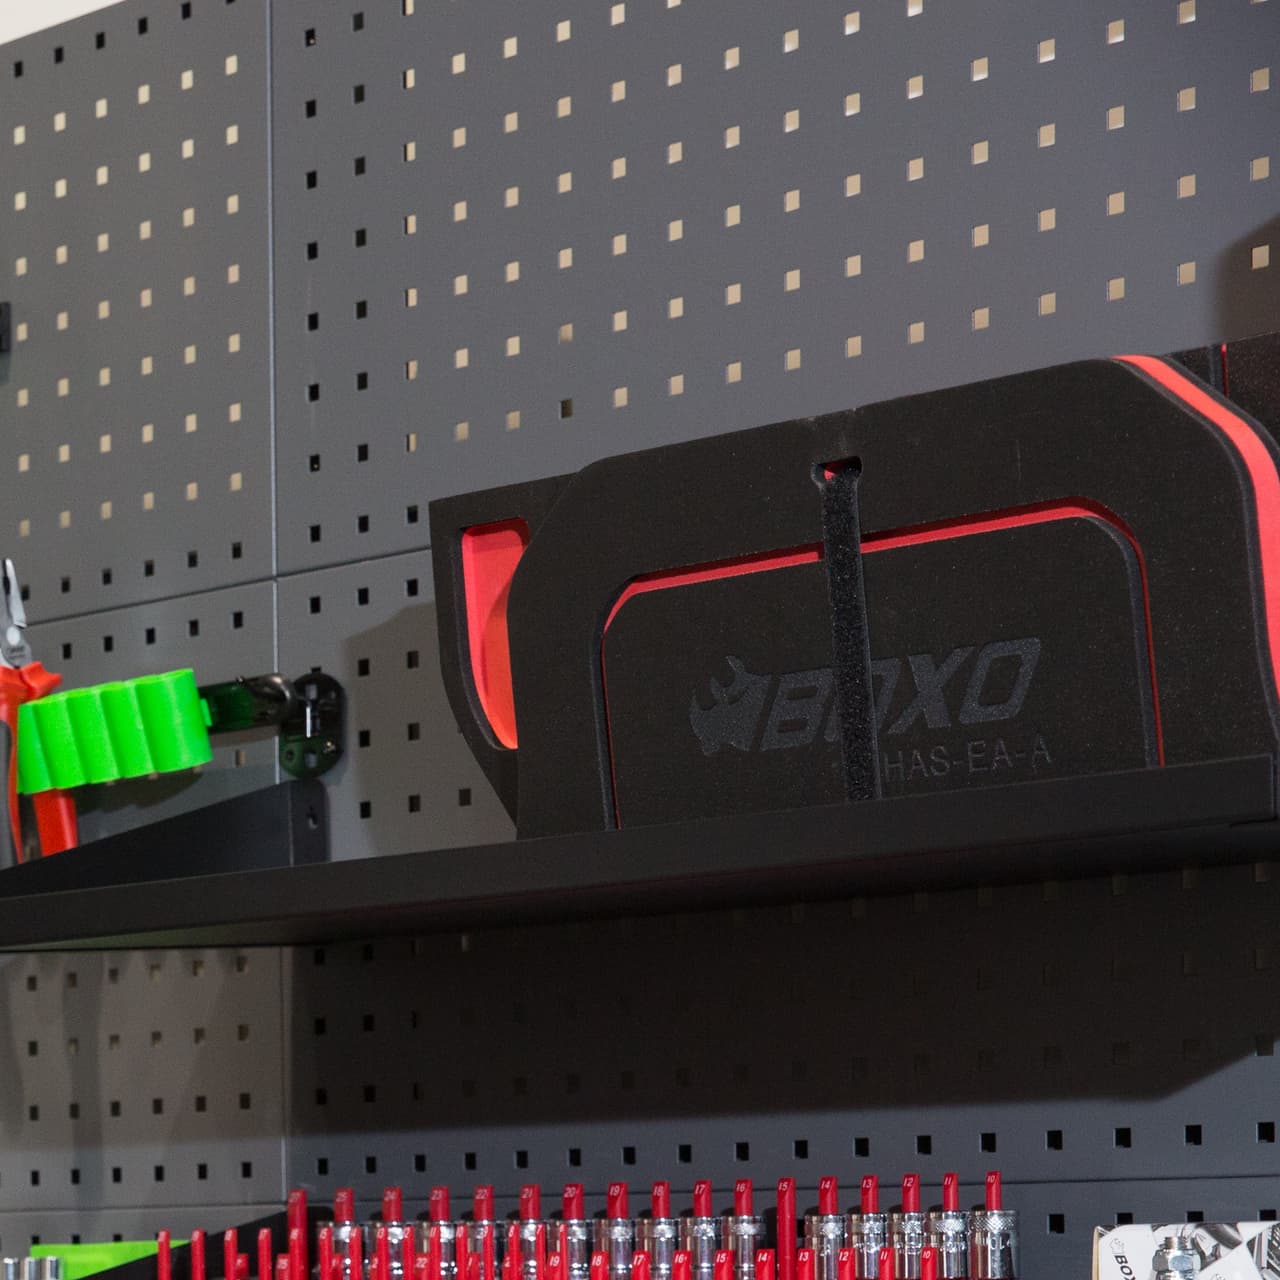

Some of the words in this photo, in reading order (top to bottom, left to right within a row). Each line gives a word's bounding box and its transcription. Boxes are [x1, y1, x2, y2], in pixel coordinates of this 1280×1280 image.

[820, 1180, 831, 1189] 14
[862, 1179, 873, 1189] 13
[903, 1177, 914, 1187] 12
[943, 1177, 952, 1185] 11
[987, 1175, 995, 1183] 10
[609, 1185, 620, 1196] 19
[653, 1185, 664, 1196] 18
[694, 1184, 705, 1195] 17
[735, 1183, 746, 1193] 16
[777, 1181, 788, 1191] 15
[431, 1189, 442, 1200] 23
[475, 1189, 487, 1200] 22
[521, 1188, 533, 1199] 21
[564, 1187, 576, 1198] 20
[633, 1254, 645, 1266] 17
[674, 1253, 684, 1263] 16
[716, 1253, 727, 1263] 15
[757, 1252, 768, 1263] 14
[798, 1251, 809, 1262] 13
[838, 1251, 849, 1262] 12
[880, 1250, 888, 1260] 11
[922, 1250, 931, 1259] 10
[415, 1257, 427, 1269] 22
[549, 1255, 560, 1267] 19
[591, 1255, 602, 1267] 18
